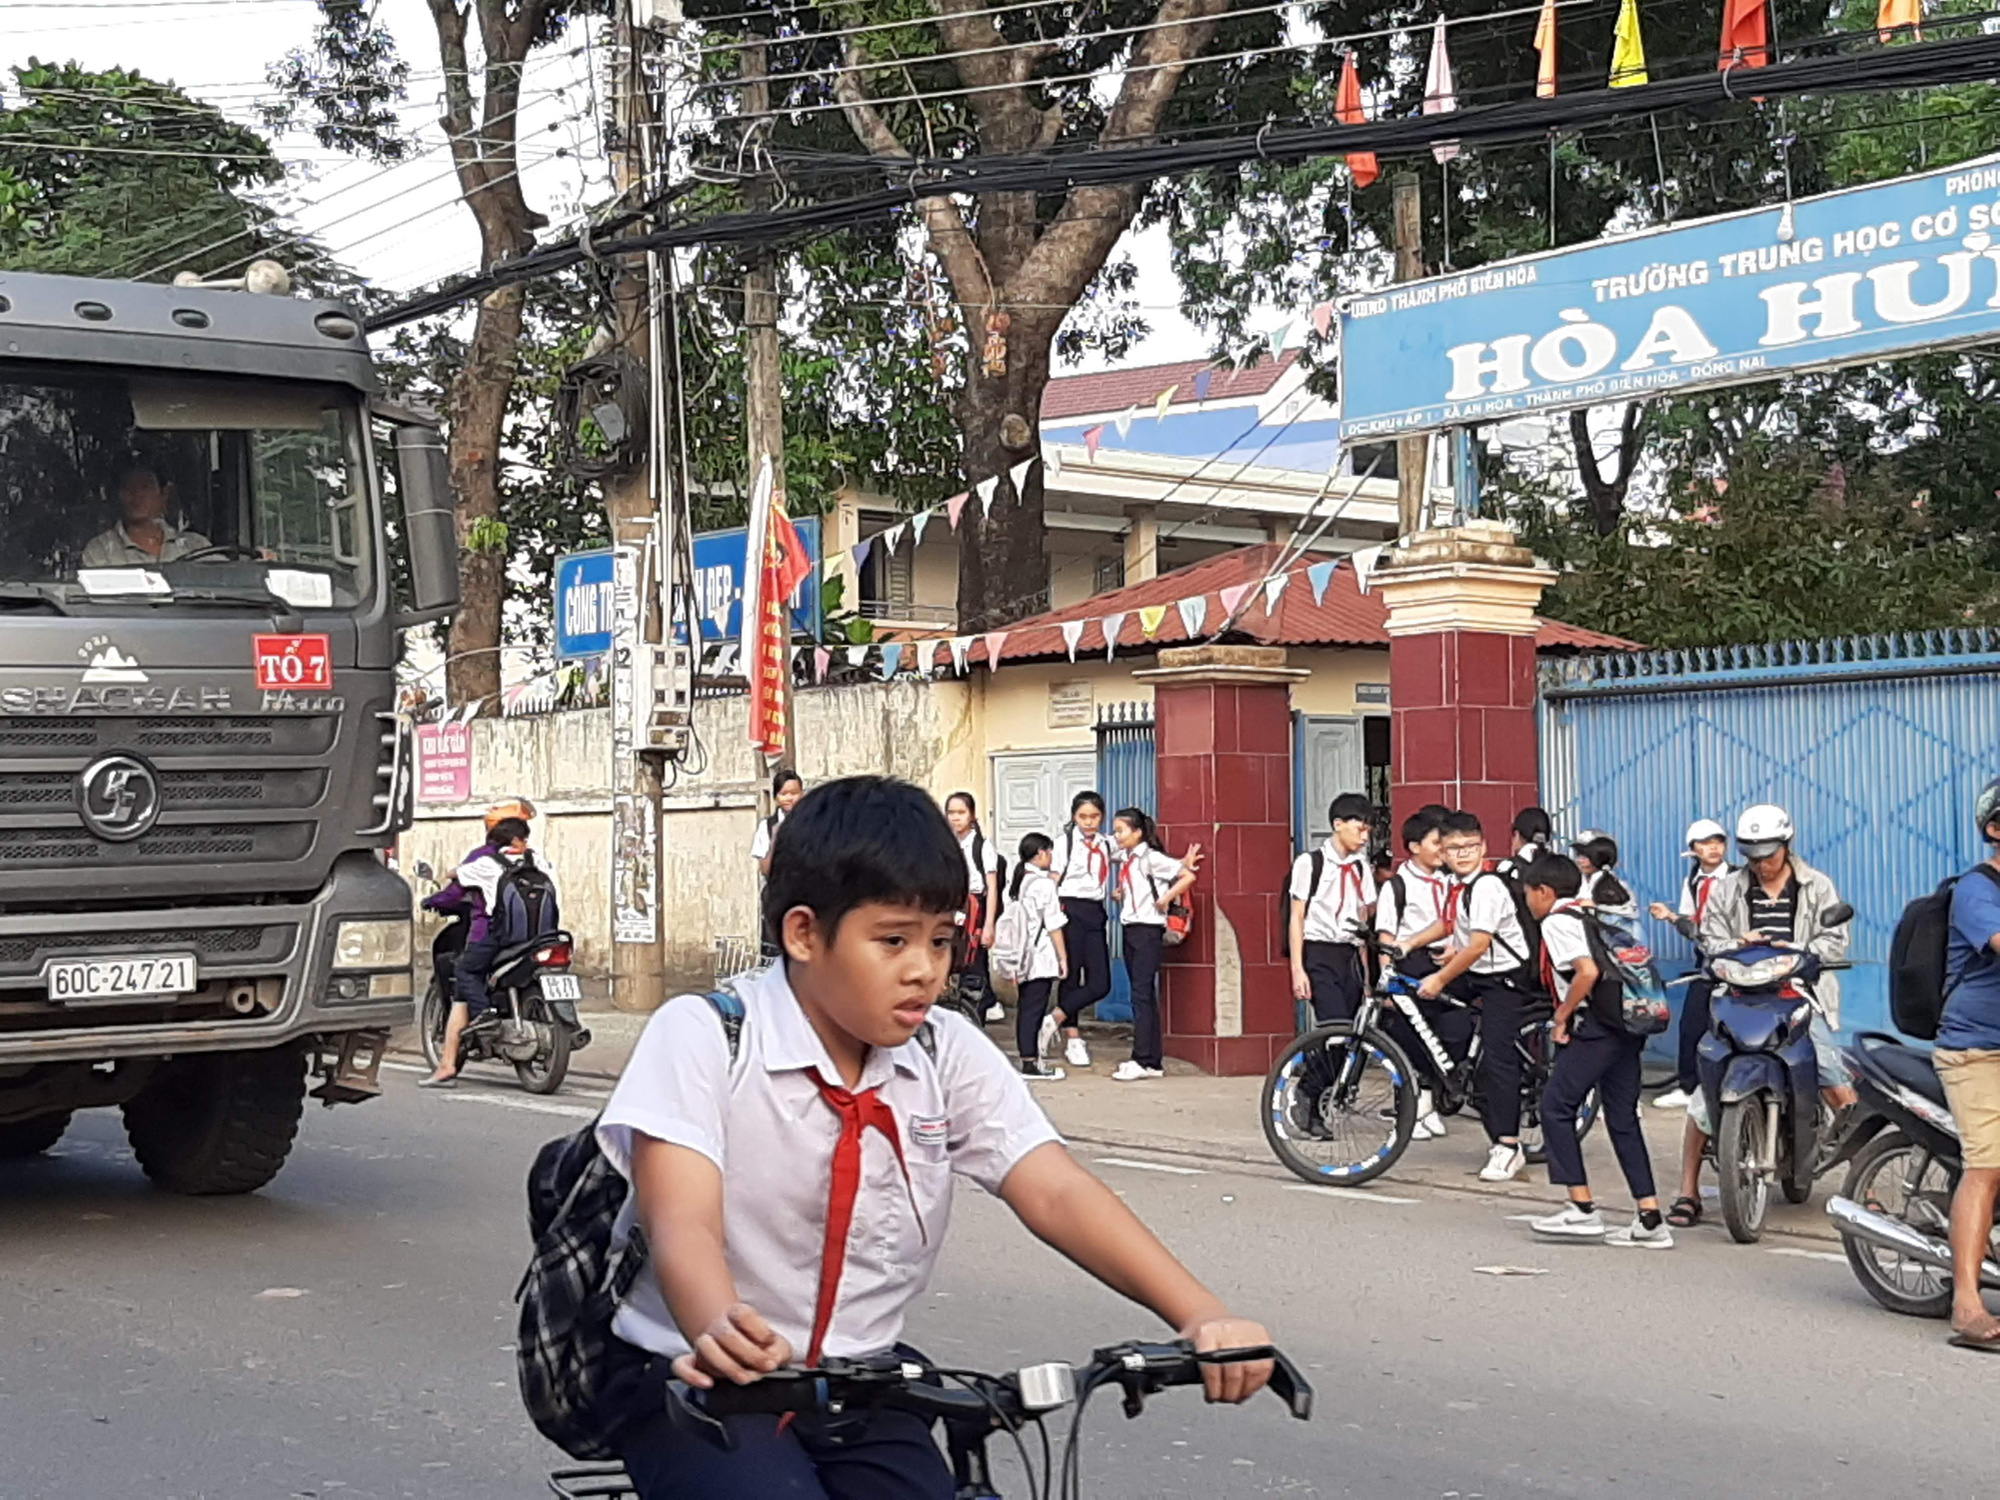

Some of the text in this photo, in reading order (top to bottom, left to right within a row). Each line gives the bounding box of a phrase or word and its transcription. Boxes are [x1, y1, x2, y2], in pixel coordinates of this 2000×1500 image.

[1946, 168, 2000, 197] PHÒN
[1591, 260, 1709, 302] TRƯỜNG
[1719, 237, 1823, 278] TRUNG
[1834, 222, 1900, 257] HỌC
[1911, 206, 1957, 241] CƠ
[1391, 286, 1437, 311] THÀNH
[1439, 276, 1468, 299] PHỐ
[1507, 265, 1537, 287] HÒA
[1445, 305, 1718, 400] HÒA
[1739, 355, 1766, 371] NAI
[261, 639, 325, 682] TỔ 7
